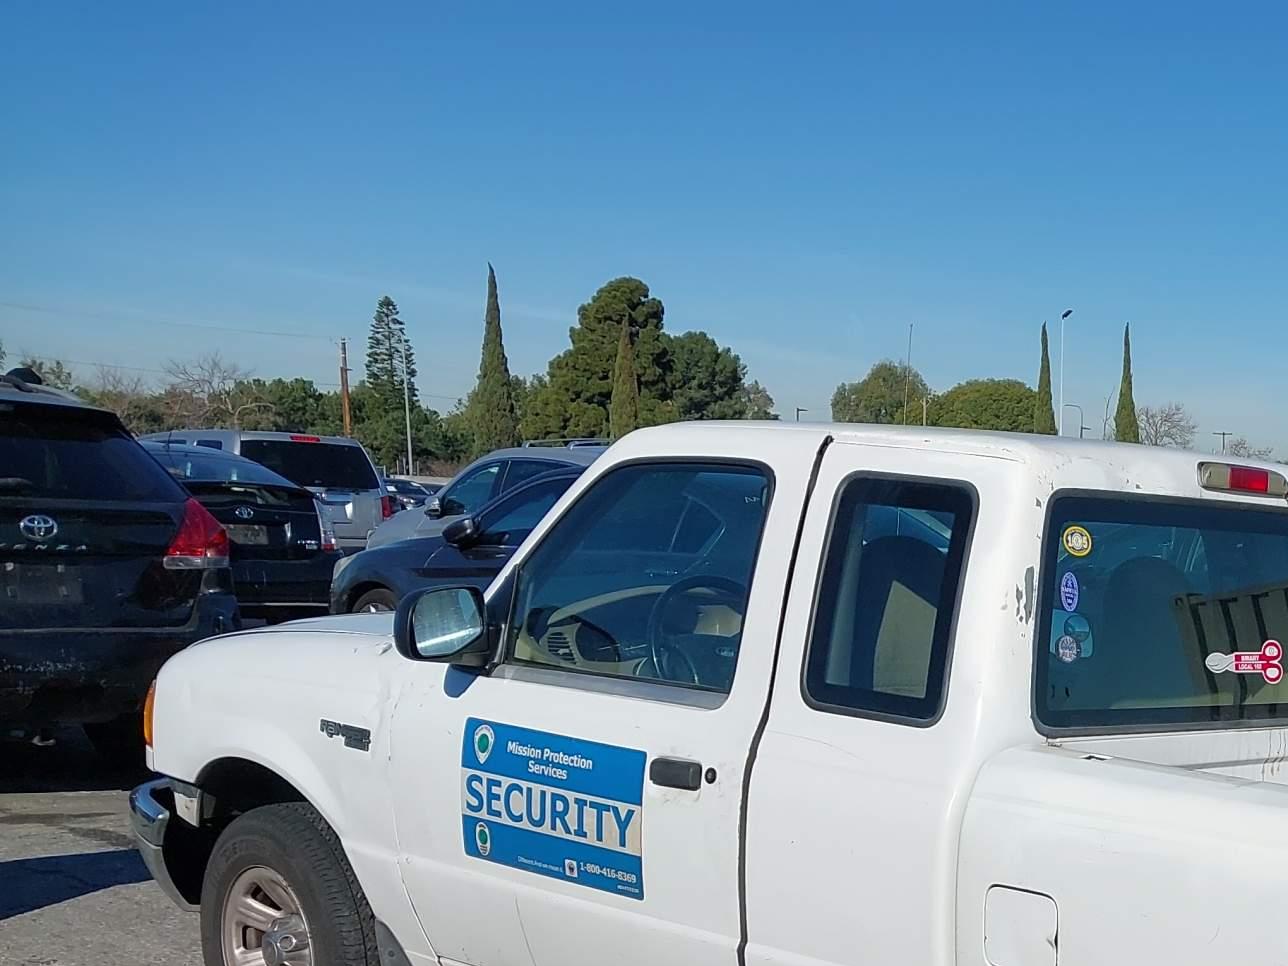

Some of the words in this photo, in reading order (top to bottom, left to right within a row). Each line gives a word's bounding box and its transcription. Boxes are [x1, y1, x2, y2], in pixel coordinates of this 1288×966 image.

[507, 740, 541, 760] Mission
[543, 749, 593, 770] Protection
[527, 760, 568, 780] Services
[465, 773, 636, 849] SECURITY
[580, 861, 637, 884] 1-800-416-8369
